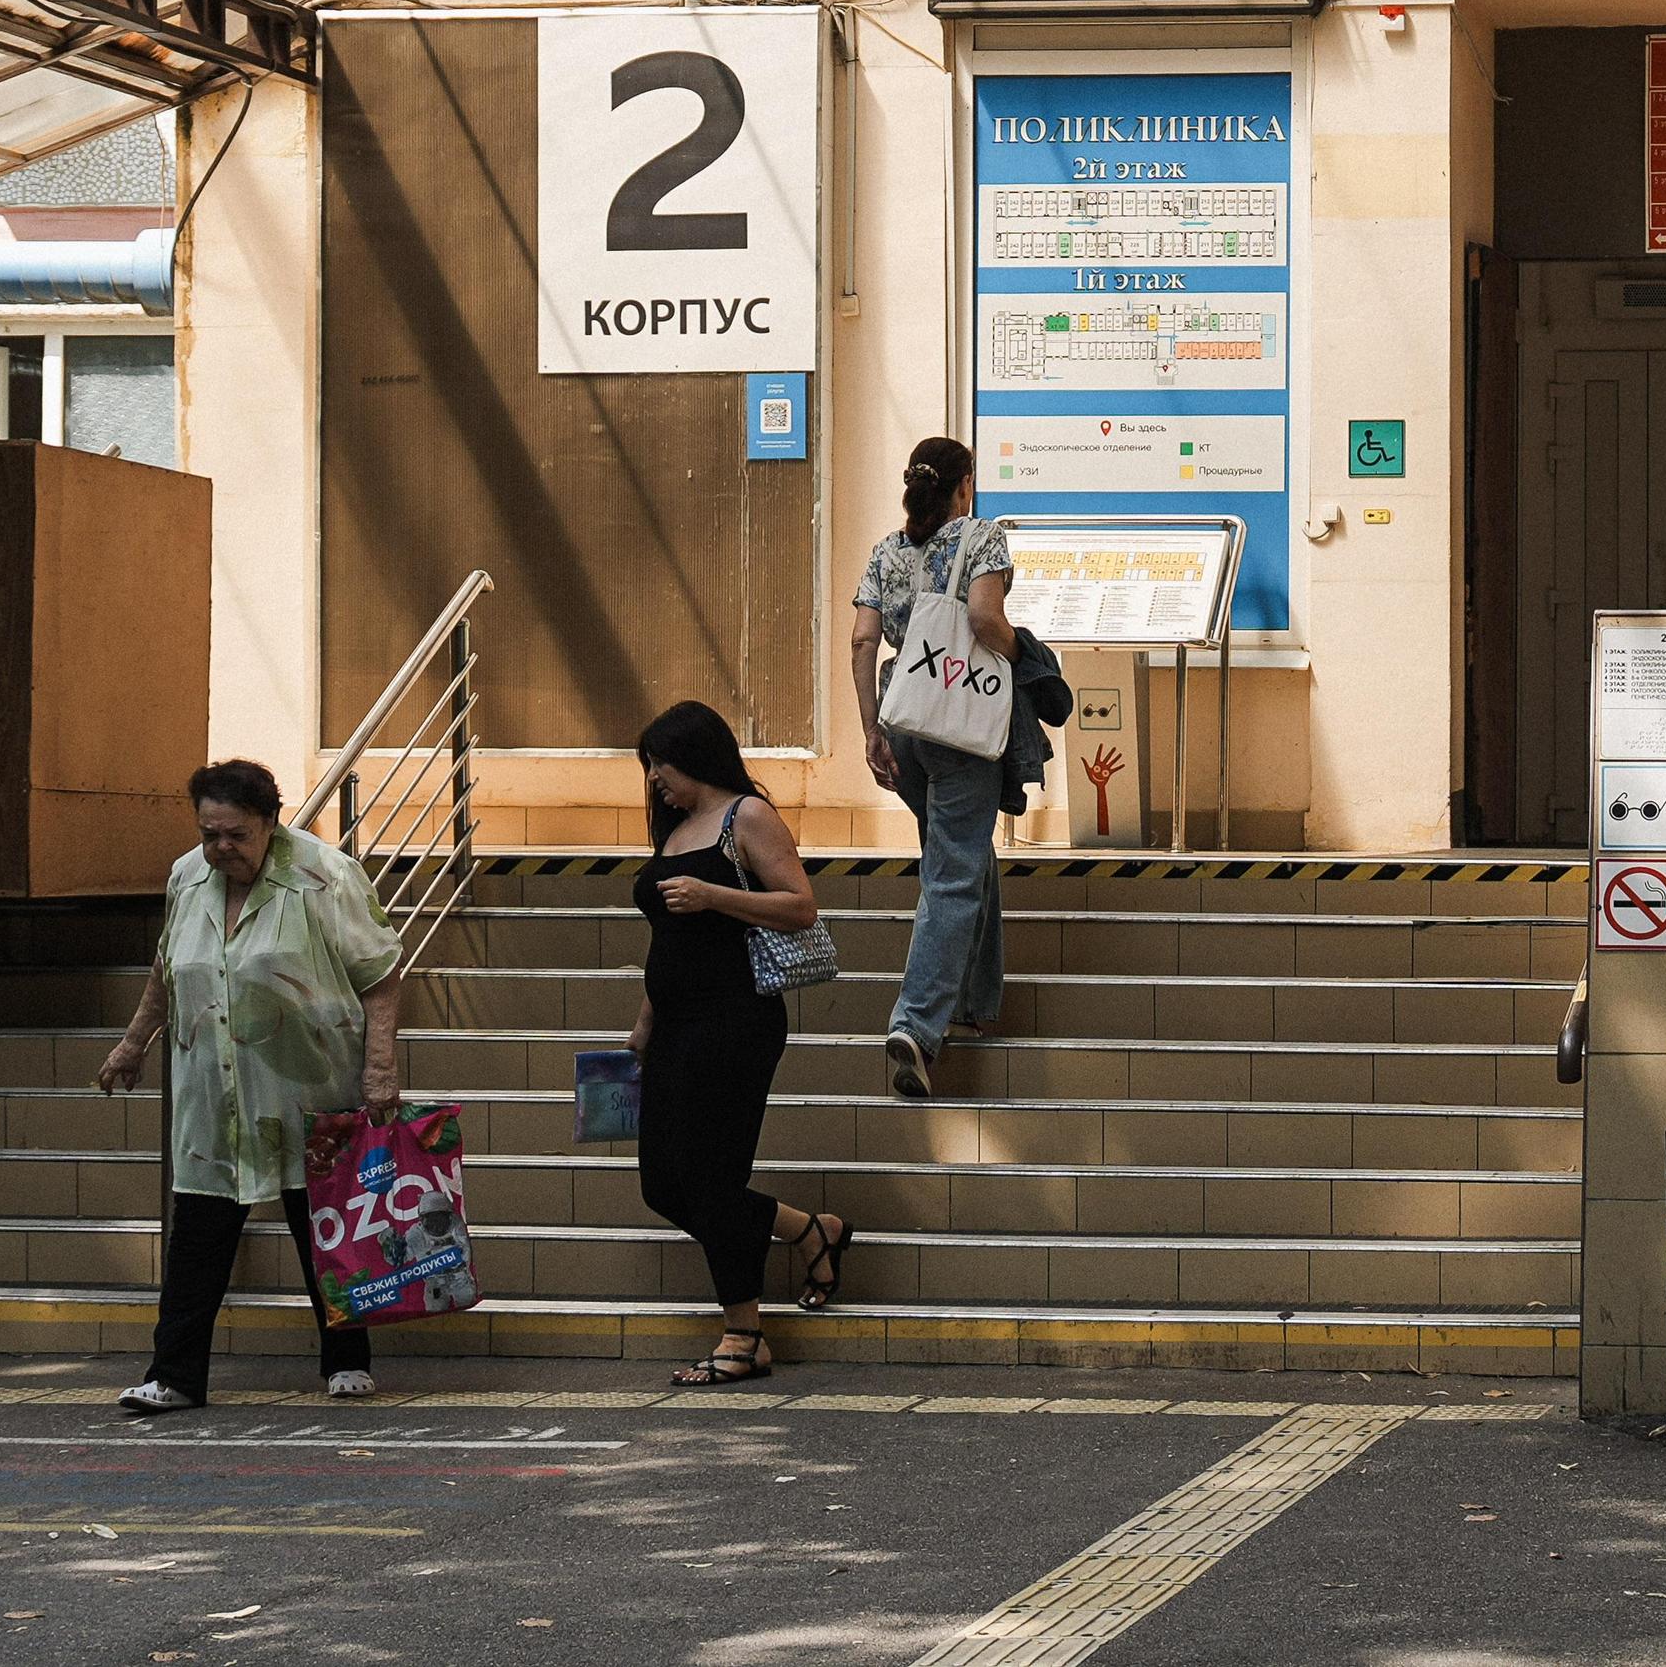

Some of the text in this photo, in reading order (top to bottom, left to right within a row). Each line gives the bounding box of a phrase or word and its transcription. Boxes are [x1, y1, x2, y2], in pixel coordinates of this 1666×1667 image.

[993, 115, 1286, 143] ПОЛИКЛИНИКА
[607, 50, 748, 251] 2
[1073, 157, 1187, 179] 2й этаж
[1072, 268, 1185, 291] 1й этаж
[584, 297, 771, 336] КОРПУС
[1120, 423, 1166, 434] Вы здесь
[1019, 443, 1152, 453] Эндоскопическое отделение
[1199, 443, 1211, 452] КТ
[1019, 466, 1039, 476] УЗИ
[1199, 466, 1263, 477] Процедурные
[1661, 634, 1666, 642] 2
[352, 1252, 457, 1298] СВЕЖИЕ ПРОДУКТЫ
[357, 1290, 396, 1310] ЗА ЧАС
